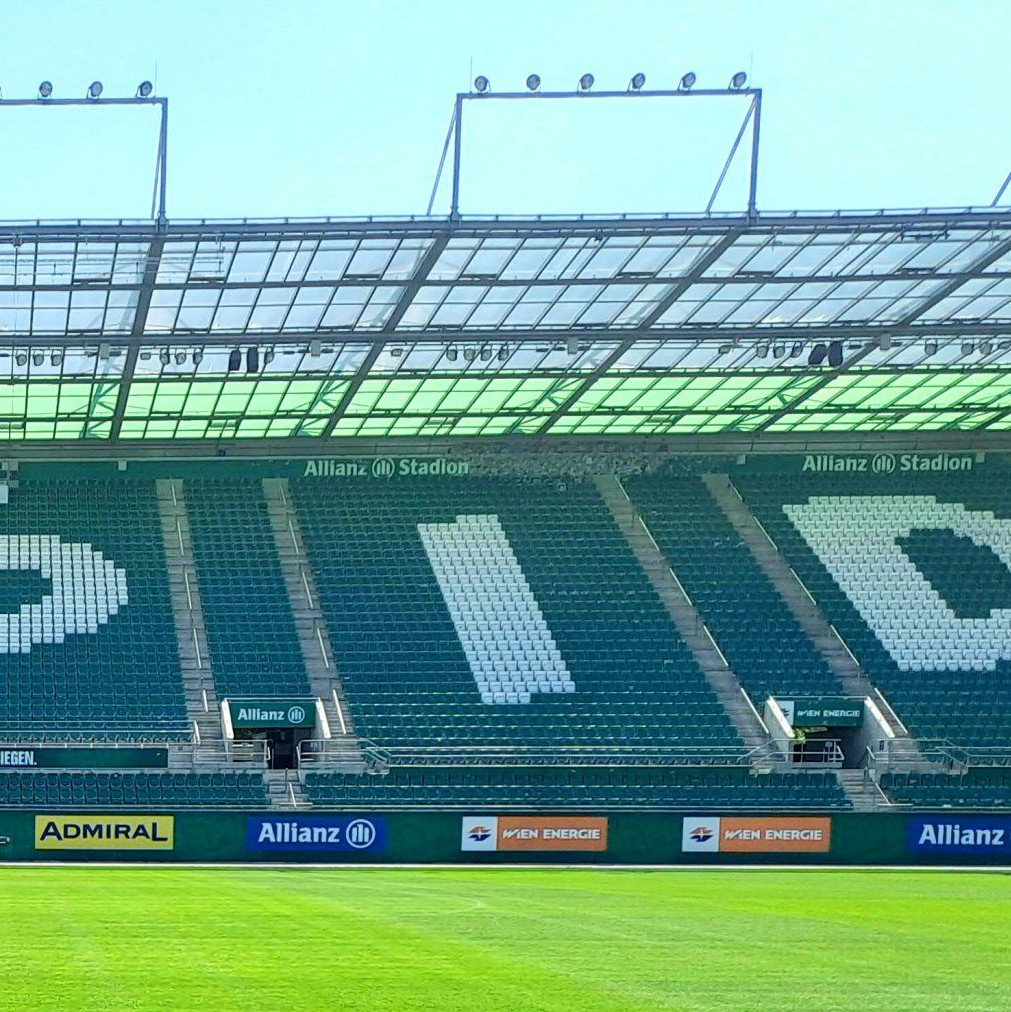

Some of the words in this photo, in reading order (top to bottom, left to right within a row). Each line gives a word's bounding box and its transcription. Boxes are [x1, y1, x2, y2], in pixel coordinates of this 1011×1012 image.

[304, 459, 367, 476] Allianz
[399, 458, 469, 476] Stadion
[802, 454, 867, 472] Allianz
[900, 453, 972, 471] Stadion
[237, 708, 285, 721] Allianz
[40, 821, 168, 842] ADMIRAL
[258, 822, 340, 843] Allianz
[502, 828, 538, 839] WIEN
[543, 829, 600, 839] ENERGIE
[724, 829, 760, 840] WIEN
[765, 830, 822, 840] ENERGIE
[918, 824, 1005, 845] Allianz
